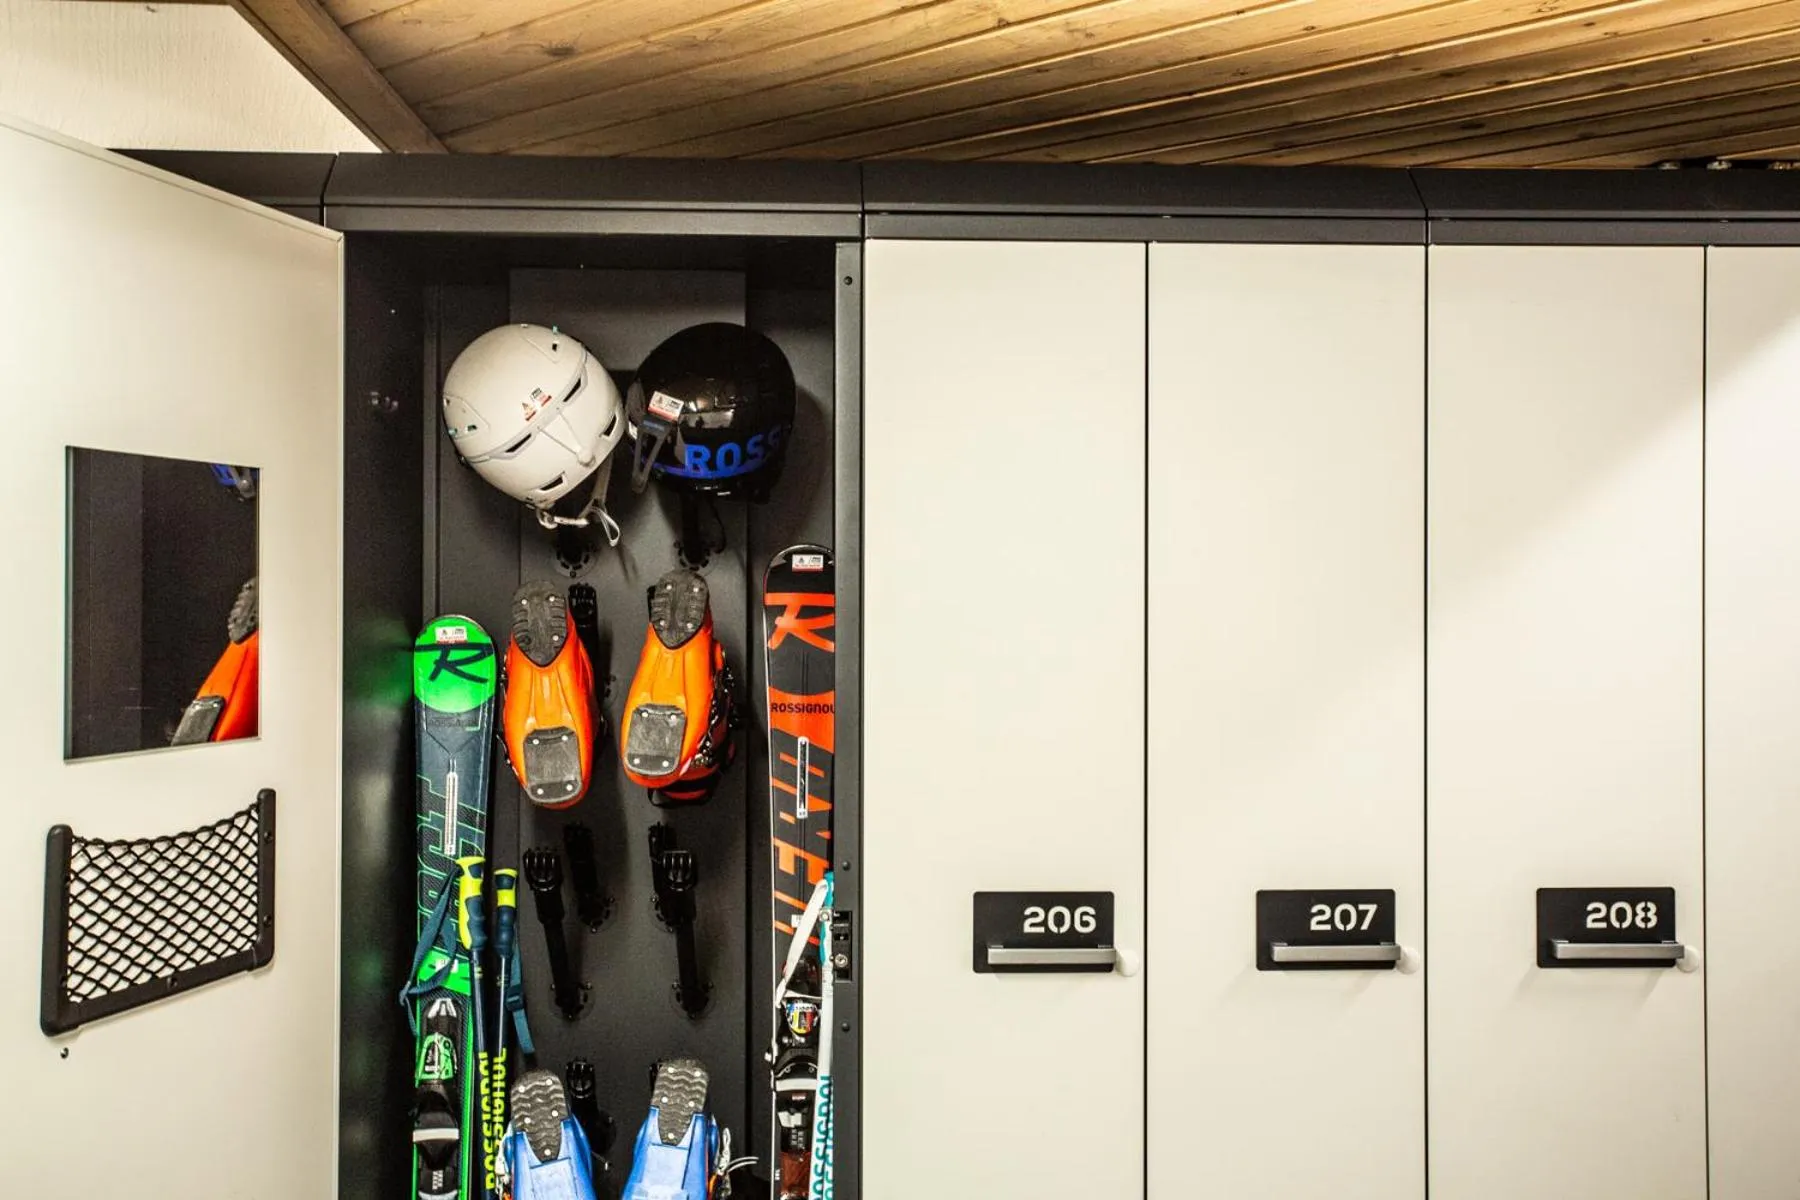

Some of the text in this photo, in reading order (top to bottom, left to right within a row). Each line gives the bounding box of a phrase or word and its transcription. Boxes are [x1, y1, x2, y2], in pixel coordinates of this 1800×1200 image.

[1024, 906, 1096, 933] 206
[1311, 904, 1377, 930] 207
[1587, 902, 1657, 928] 208
